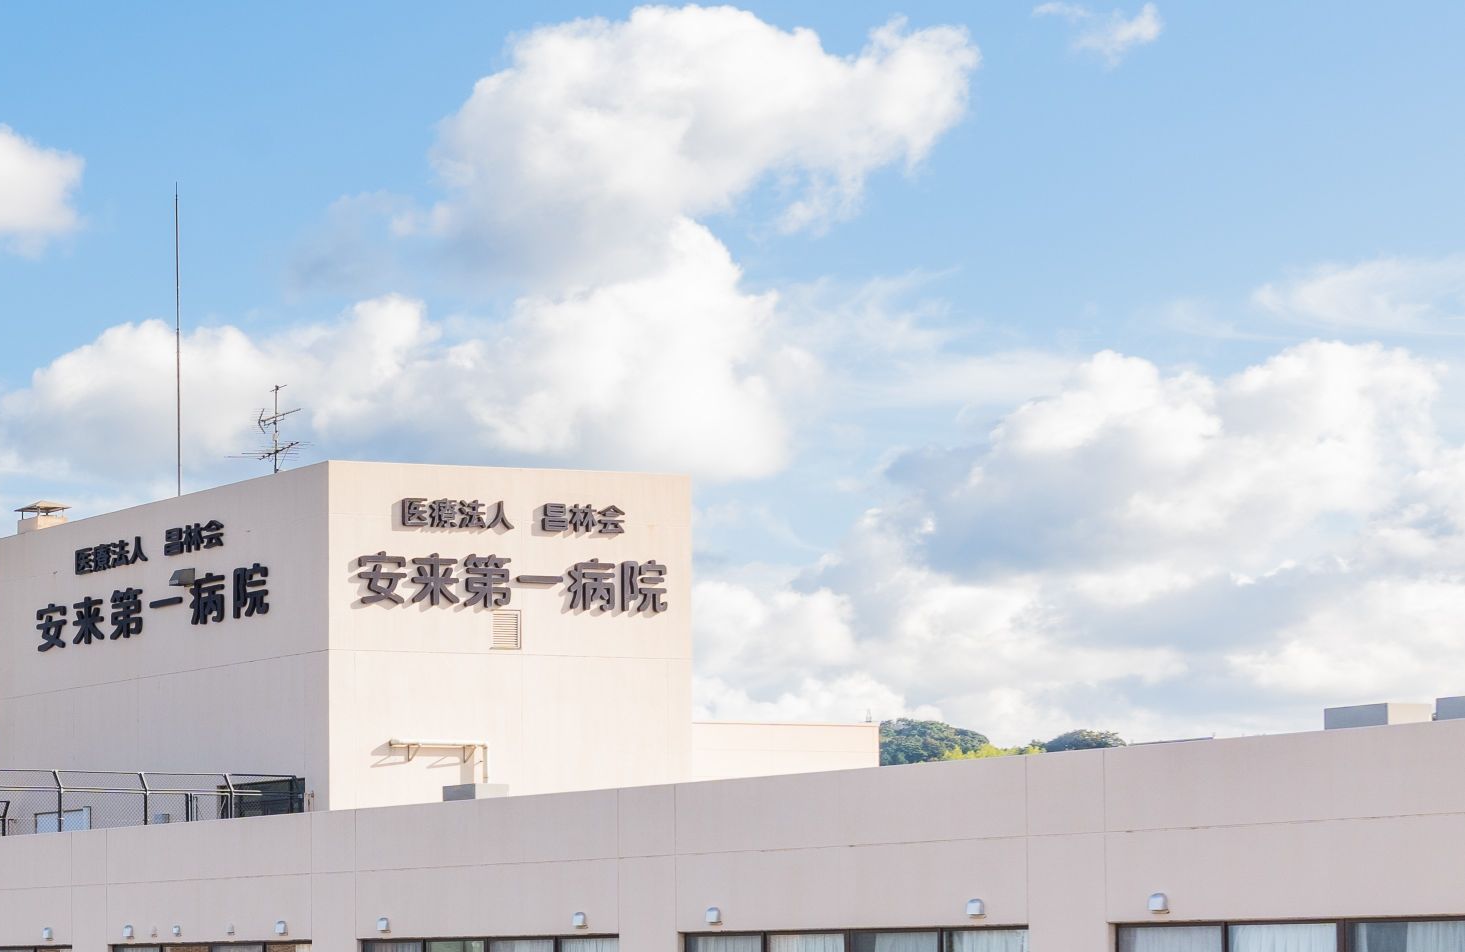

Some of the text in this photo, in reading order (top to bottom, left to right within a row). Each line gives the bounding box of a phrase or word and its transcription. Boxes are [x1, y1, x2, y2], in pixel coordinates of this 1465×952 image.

[401, 498, 625, 534] 医療法人 昌林会
[74, 520, 224, 575] 医療法人 昌林会
[36, 562, 270, 652] 安来第一病院
[357, 551, 668, 612] 安来第一病院
